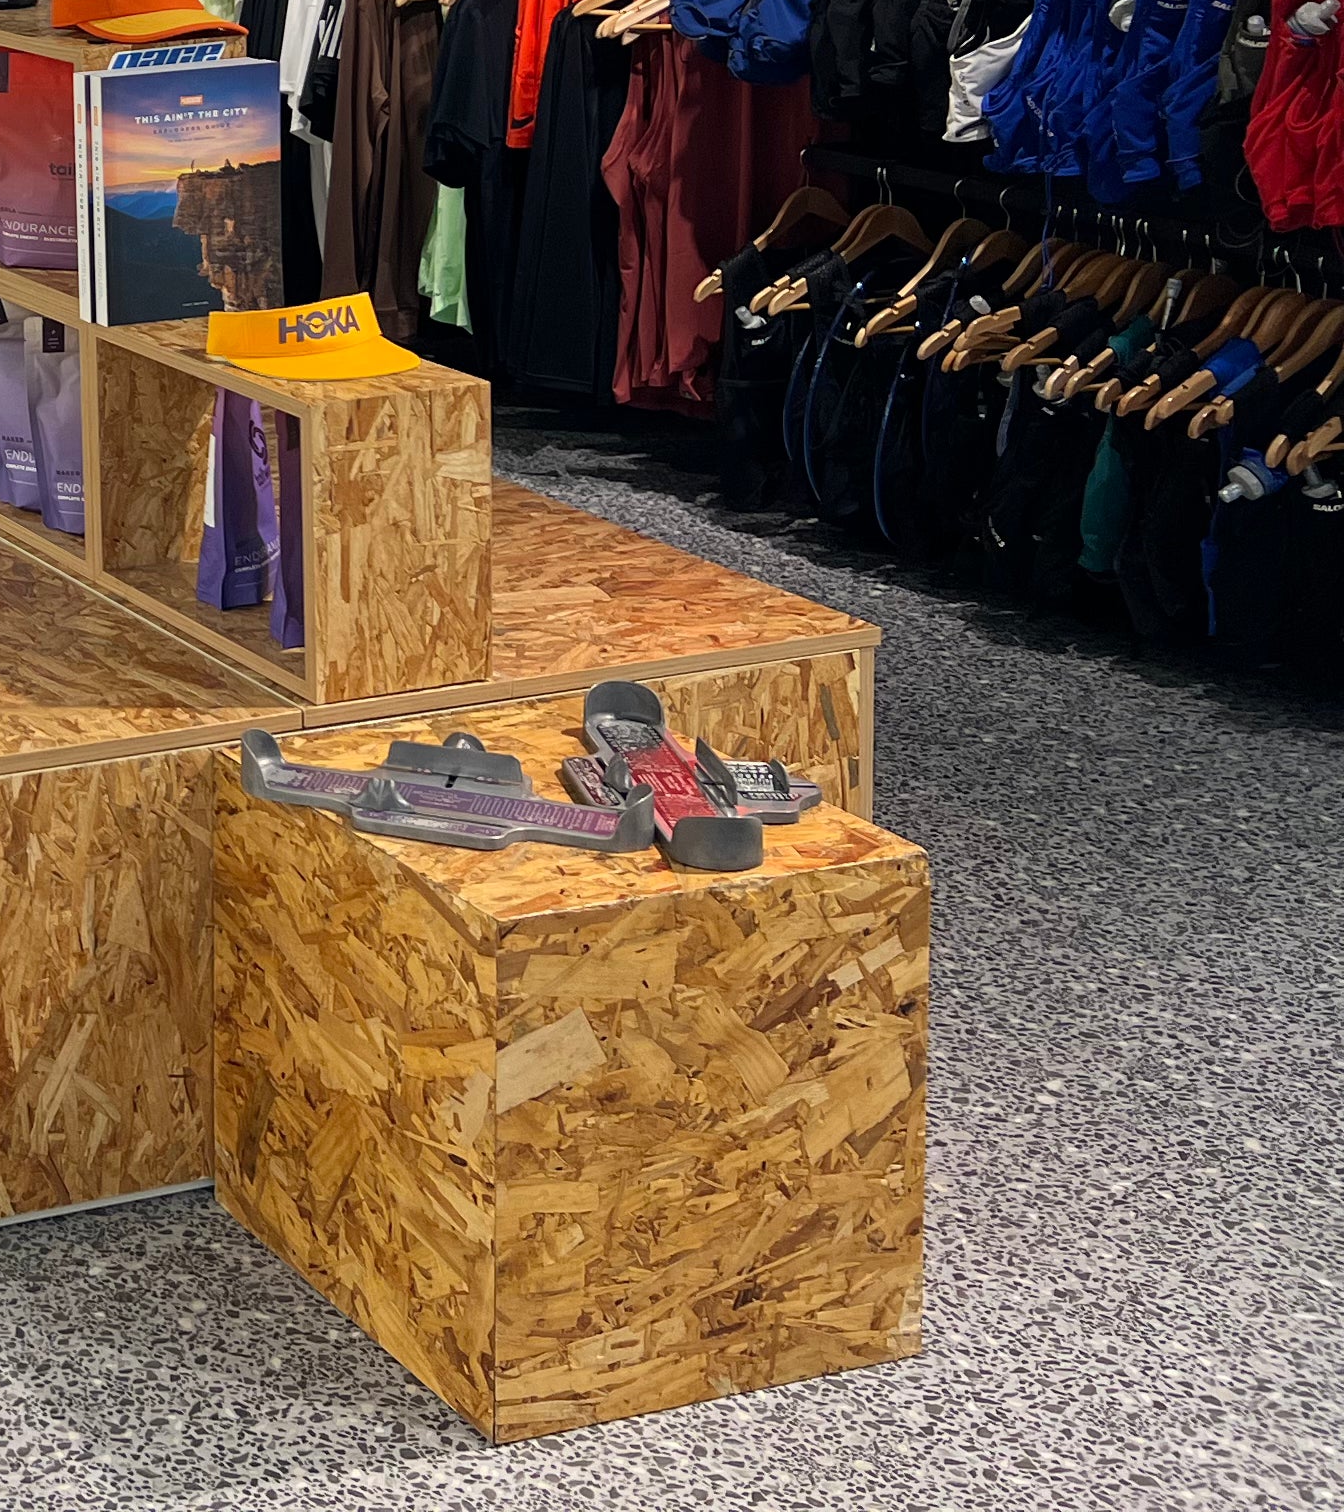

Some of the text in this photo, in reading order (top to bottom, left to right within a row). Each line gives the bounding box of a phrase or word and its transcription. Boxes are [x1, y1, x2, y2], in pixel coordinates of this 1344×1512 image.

[134, 106, 249, 125] THIS AIN'T THE CITY
[278, 304, 361, 345] HOKA
